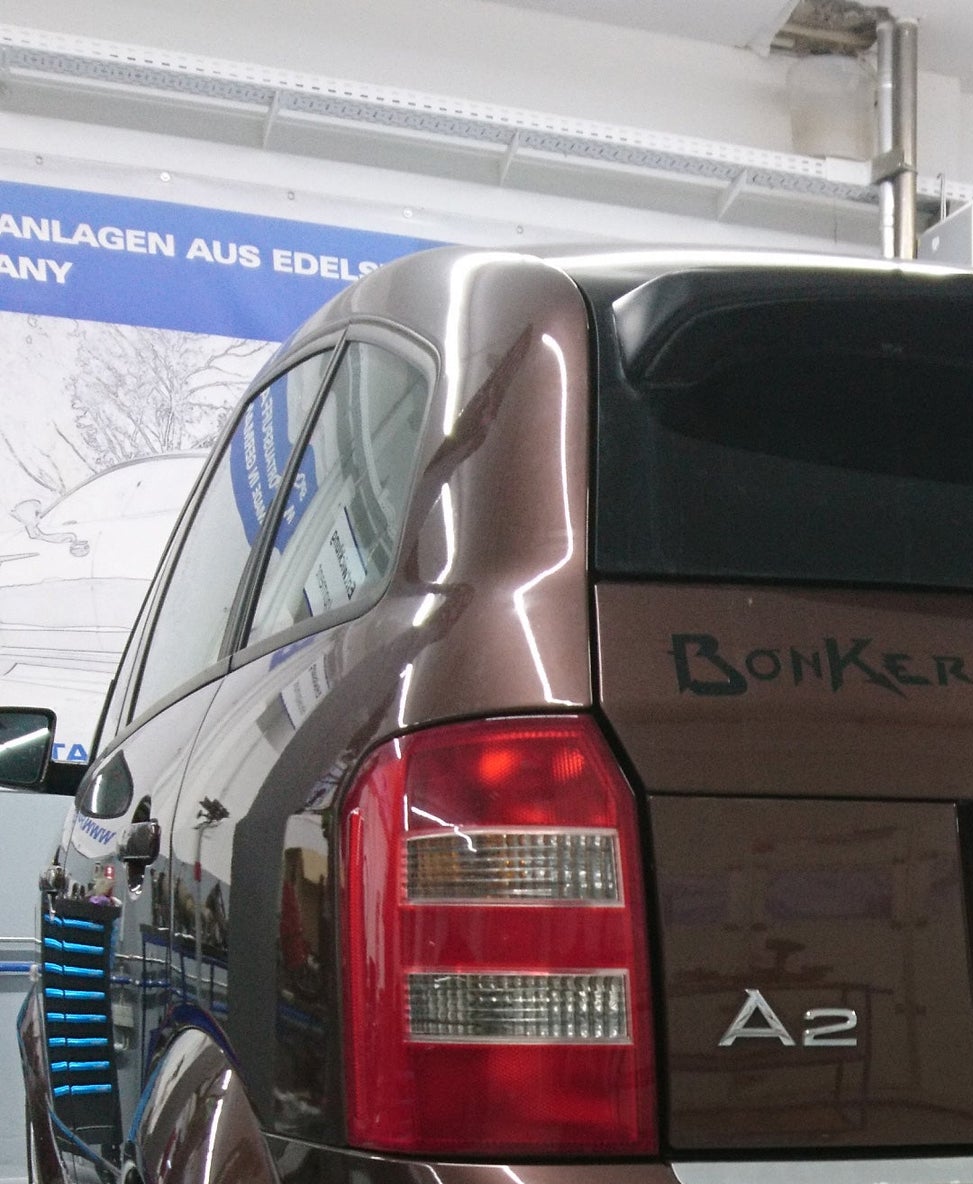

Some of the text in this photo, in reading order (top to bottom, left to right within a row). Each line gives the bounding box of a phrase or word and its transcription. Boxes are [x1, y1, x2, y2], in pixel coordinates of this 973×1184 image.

[0, 213, 384, 281] ANLAGEN AUS EDELS
[0, 254, 74, 285] ANY
[718, 988, 858, 1047] A2
